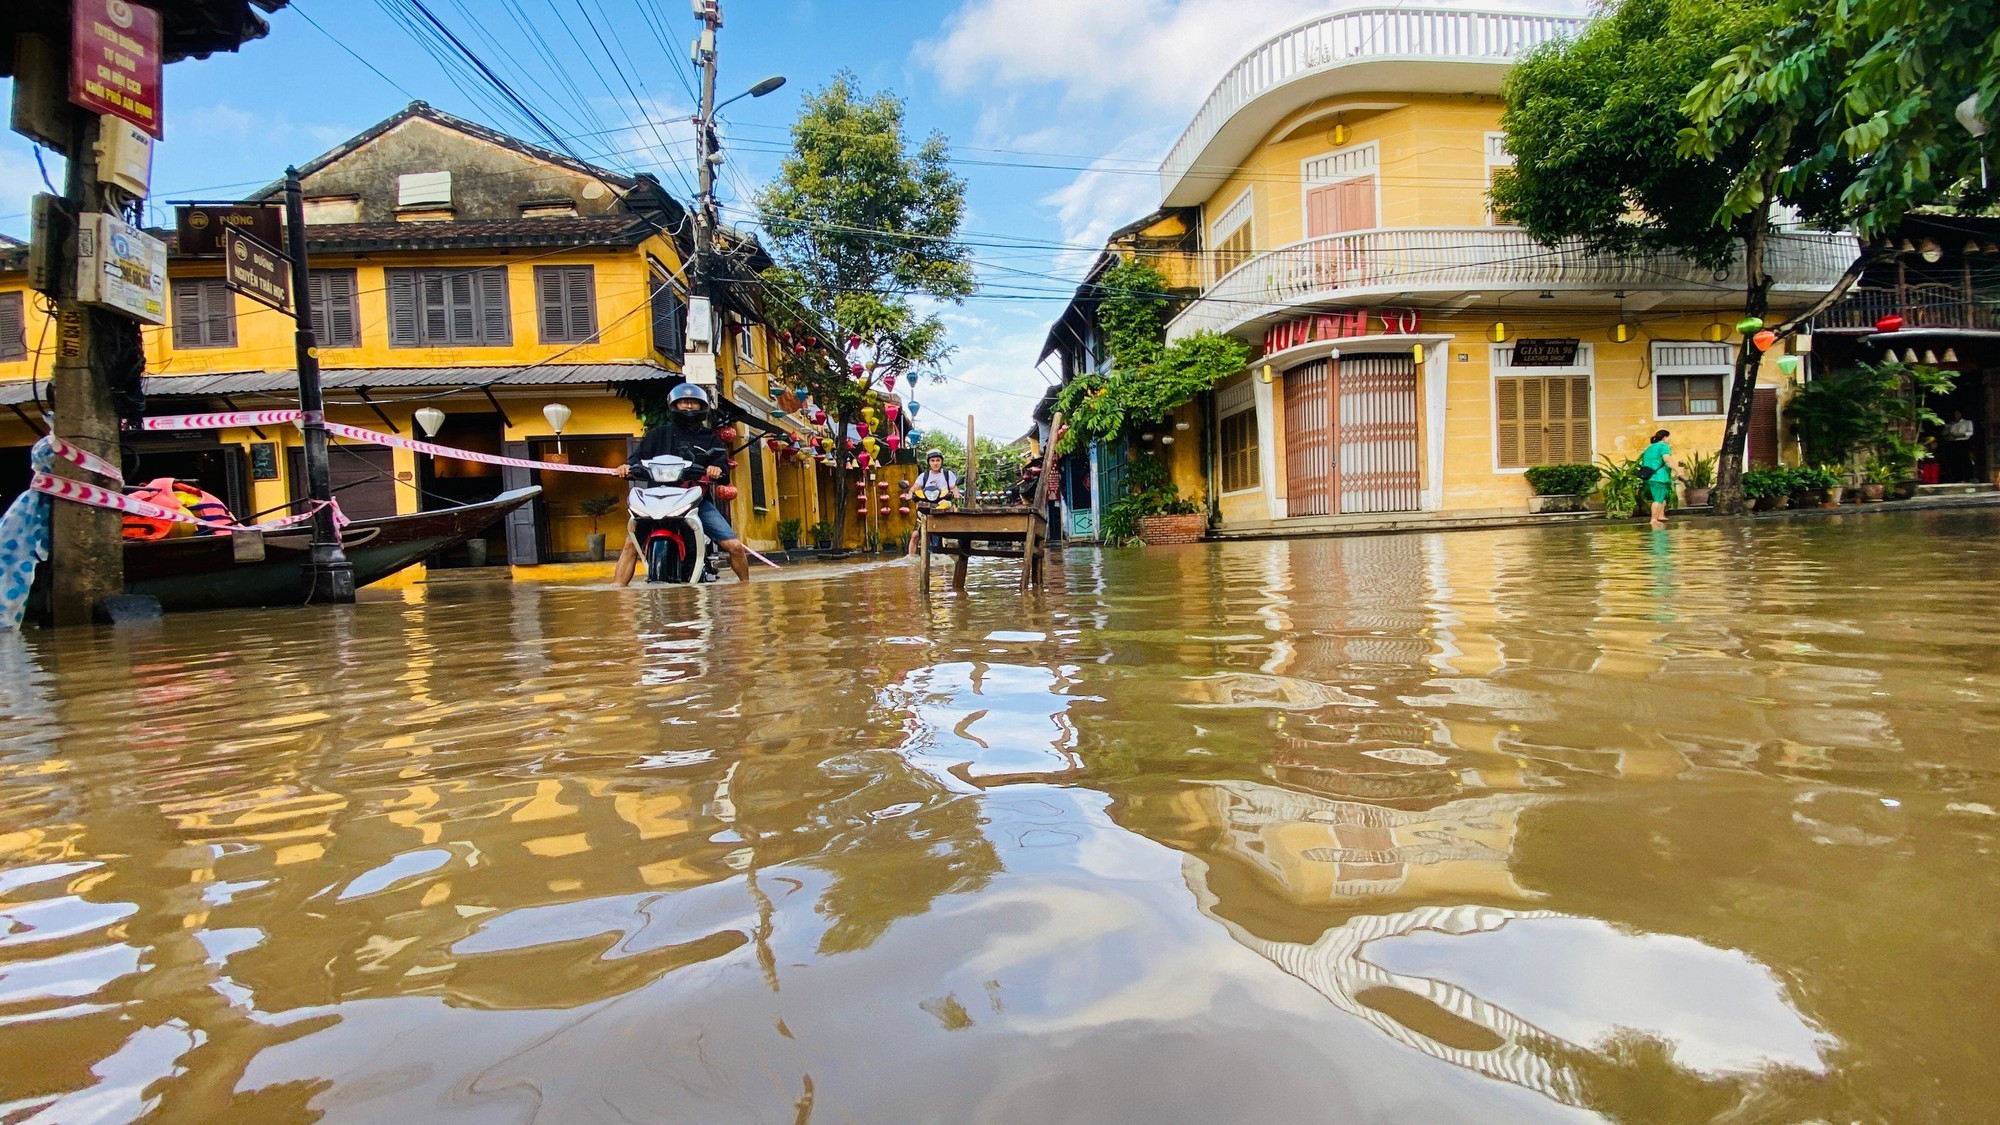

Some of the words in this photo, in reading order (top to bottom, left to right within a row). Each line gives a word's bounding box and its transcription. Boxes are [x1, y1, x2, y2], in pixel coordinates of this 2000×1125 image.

[105, 87, 121, 106] PHỐ
[253, 253, 275, 273] ĐƯỜNG
[234, 265, 259, 288] NGUYỄN
[259, 276, 273, 295] THÁI
[272, 284, 285, 301] HỌC
[1546, 346, 1560, 355] DA
